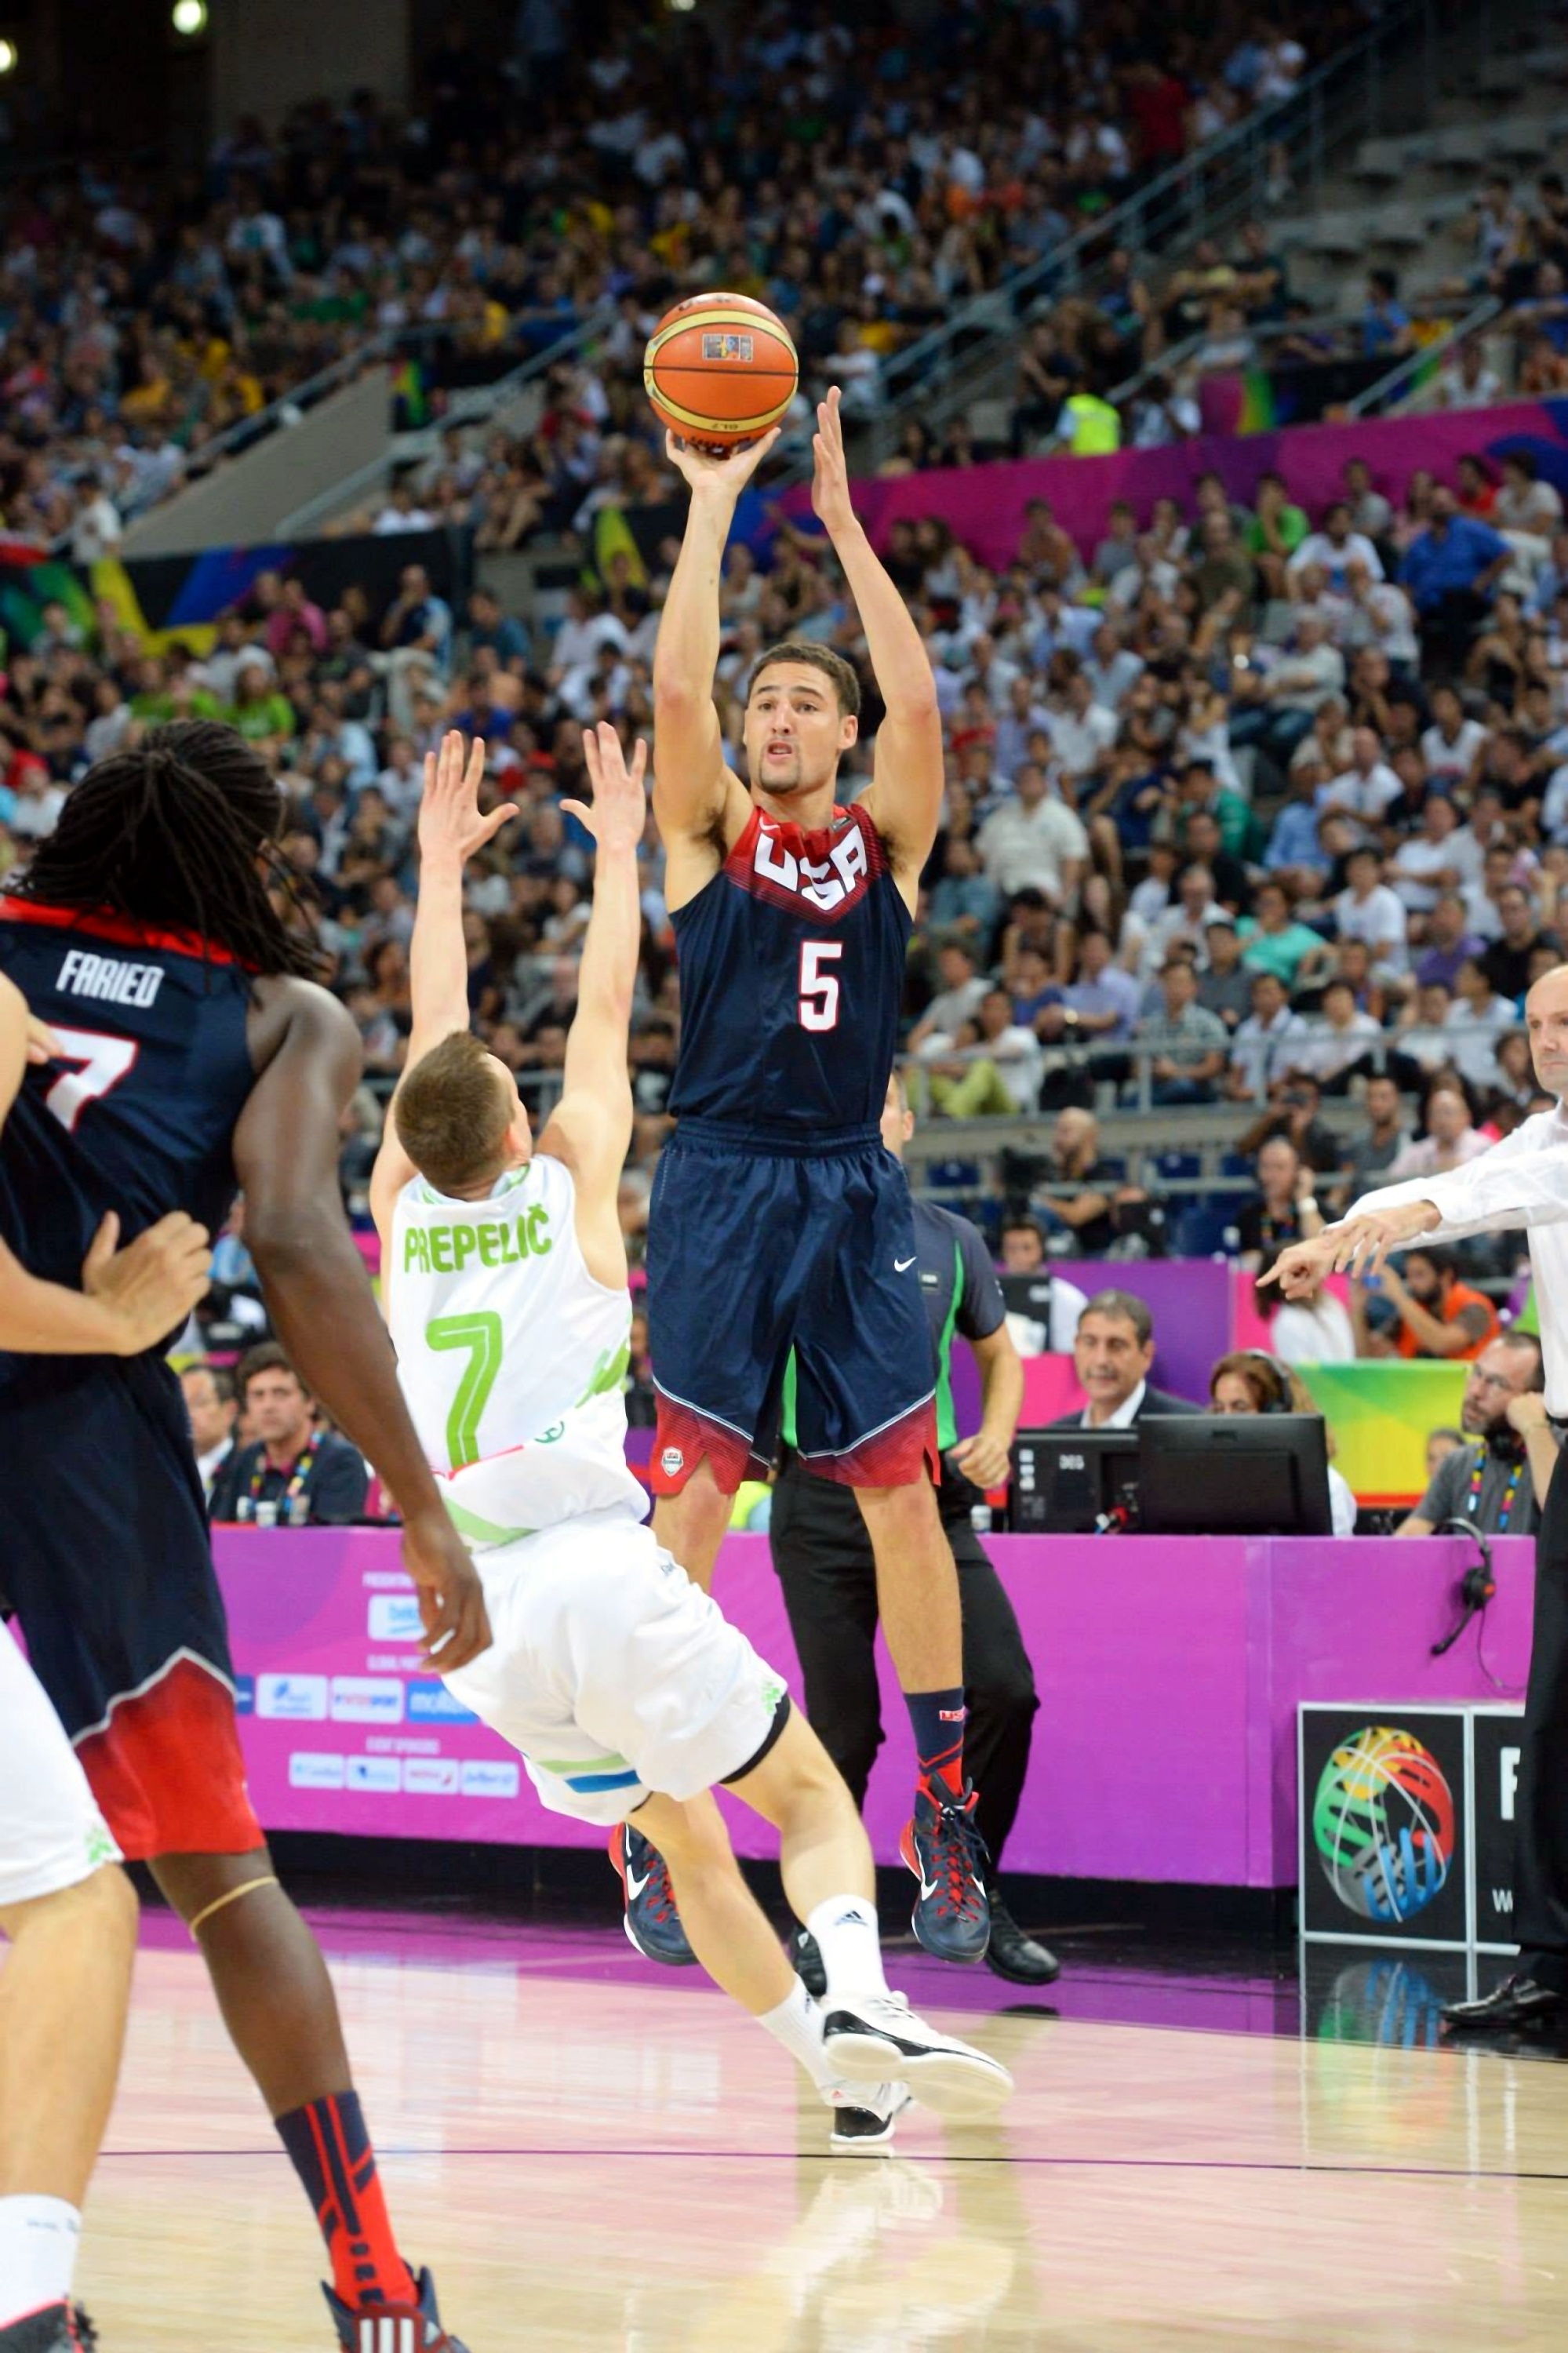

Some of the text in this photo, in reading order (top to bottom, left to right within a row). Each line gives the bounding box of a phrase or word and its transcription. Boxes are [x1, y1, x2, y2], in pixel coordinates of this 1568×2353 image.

[754, 825, 867, 911] USA
[56, 949, 165, 1009] FARIED
[799, 940, 842, 1032] 5
[45, 1024, 140, 1132] 7
[404, 1202, 552, 1275] PREPELIČ
[426, 1311, 503, 1471] 7
